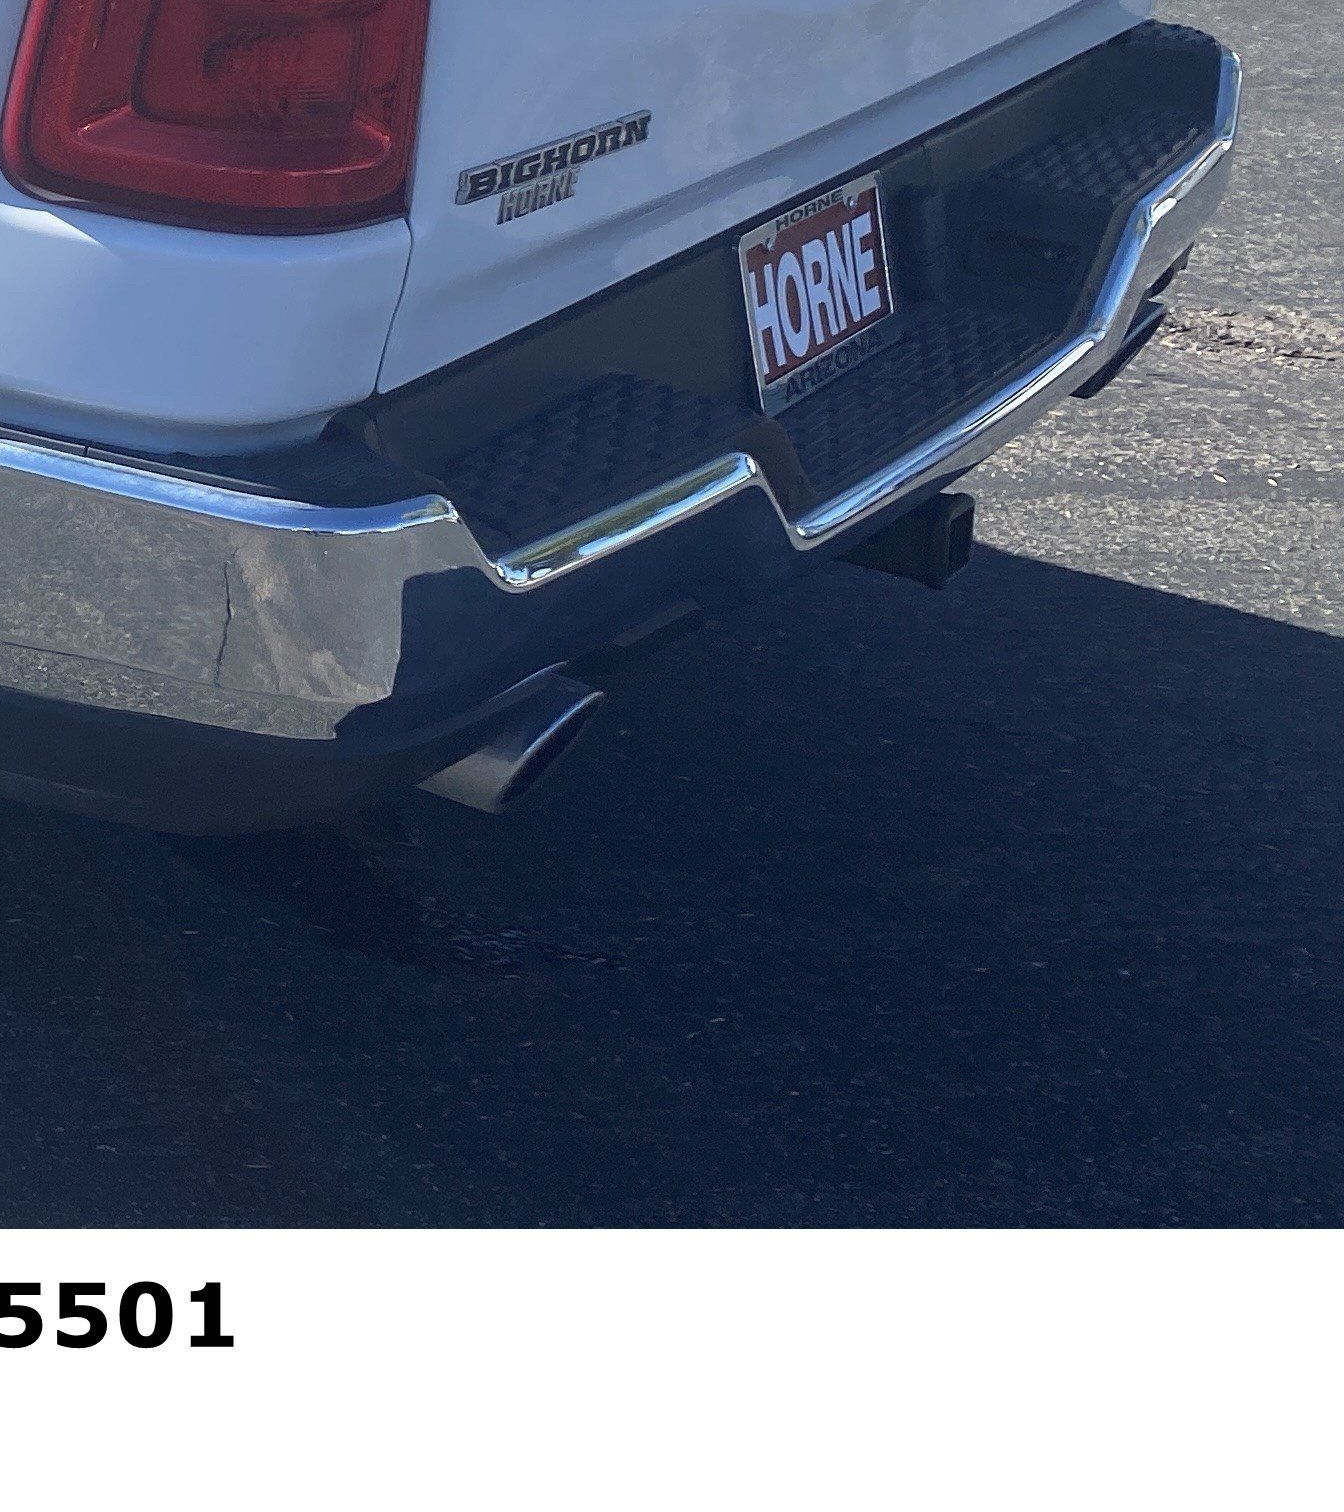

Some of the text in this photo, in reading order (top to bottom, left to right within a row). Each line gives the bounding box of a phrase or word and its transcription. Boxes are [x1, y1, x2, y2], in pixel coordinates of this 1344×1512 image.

[459, 110, 653, 204] BIGHORN
[774, 187, 846, 231] HORNE
[748, 210, 882, 376] HORNE
